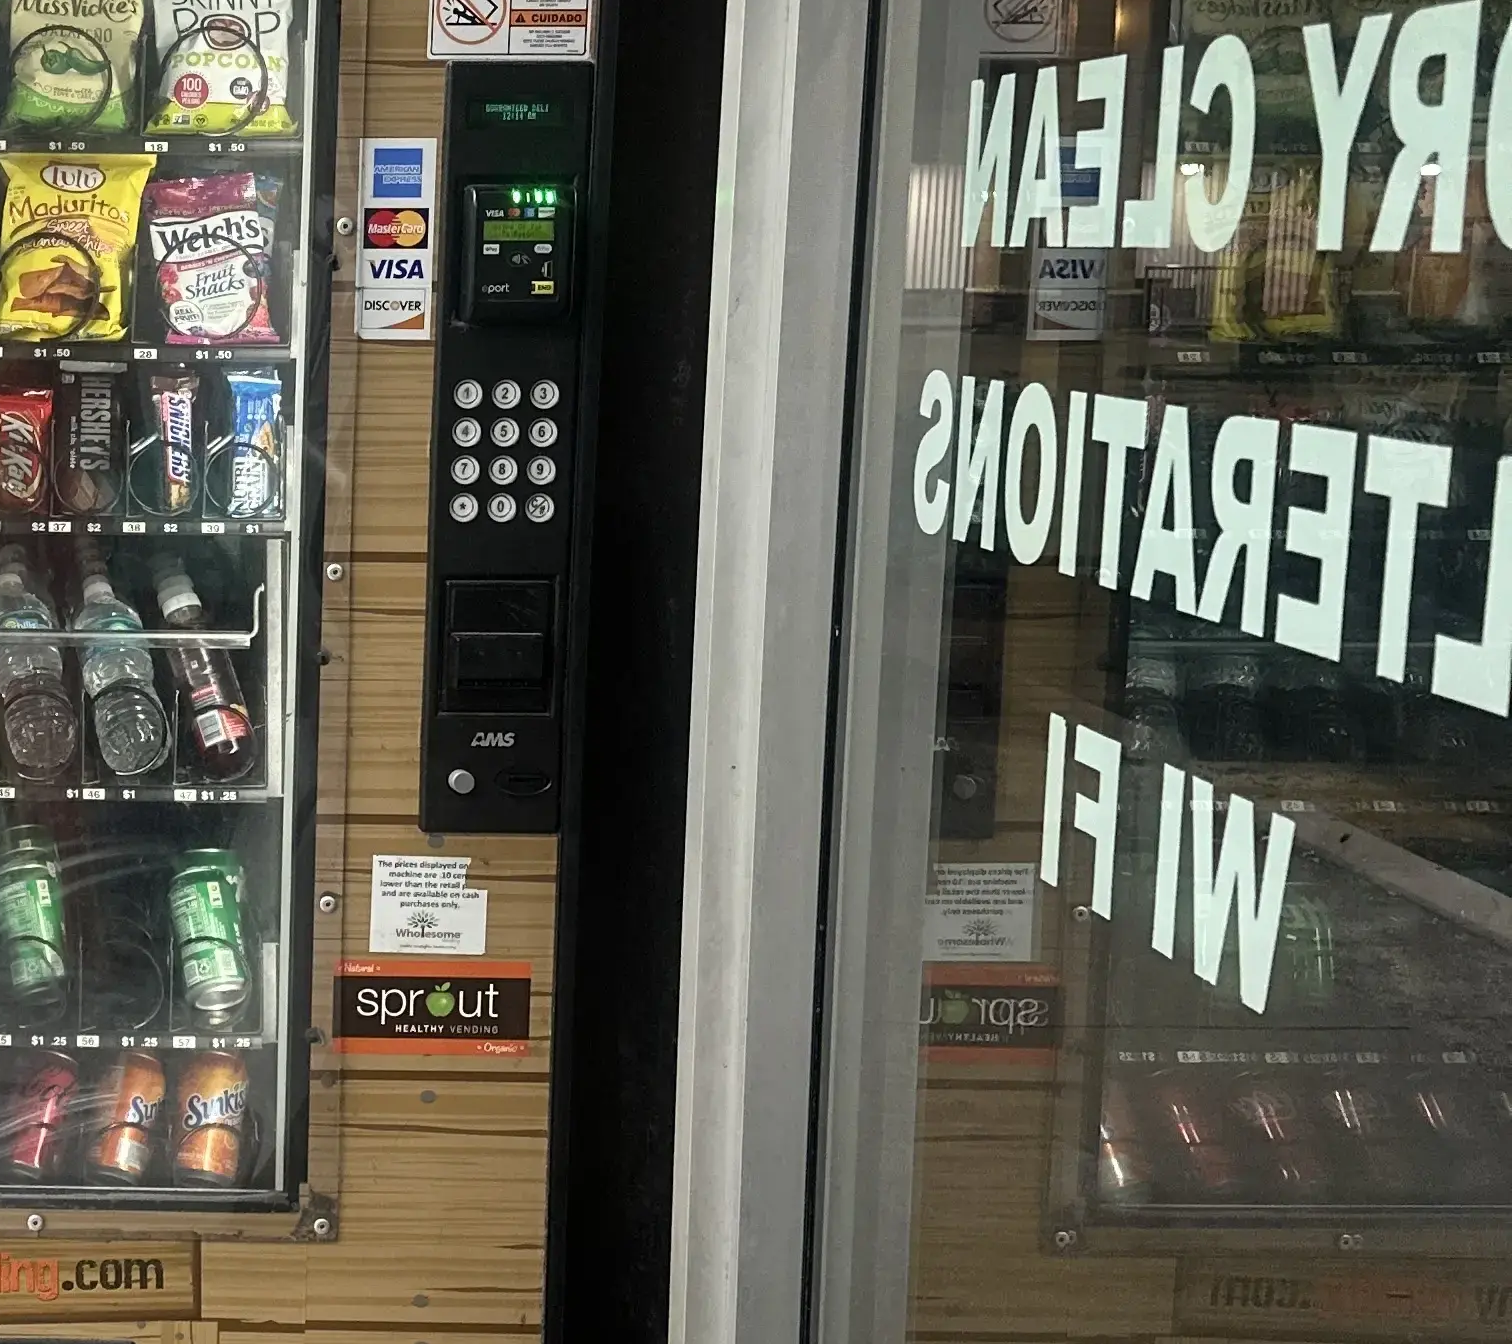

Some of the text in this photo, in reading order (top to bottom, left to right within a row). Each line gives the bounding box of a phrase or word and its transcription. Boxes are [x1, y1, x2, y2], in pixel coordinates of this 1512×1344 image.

[531, 14, 582, 23] CUIDADO
[181, 77, 202, 91] 100
[150, 144, 163, 152] 18
[374, 164, 420, 174] AMERICAN
[383, 175, 422, 184] EXPRESS
[9, 194, 131, 225] Maduritos
[485, 209, 504, 218] VISA
[46, 219, 90, 234] Sweet
[368, 223, 424, 235] MasterCard
[156, 215, 260, 255] Welch's
[195, 263, 236, 287] Fruit
[368, 259, 424, 279] VISA
[185, 277, 245, 300] Snacks
[364, 300, 422, 311] DISCOVER
[139, 350, 152, 358] 28
[463, 387, 470, 399] 1
[501, 387, 509, 400] 2
[540, 387, 547, 400] 3
[79, 375, 112, 471] HERSHEY'S
[462, 425, 469, 438] 4
[500, 425, 508, 437] 5
[538, 425, 546, 438] 6
[461, 462, 468, 475] 7
[498, 463, 506, 475] 8
[536, 463, 544, 475] 9
[497, 500, 504, 512] 0
[53, 523, 66, 531] 37
[471, 732, 515, 747] AMS
[87, 790, 101, 799] 46
[378, 860, 457, 870] The prices displayed
[388, 870, 422, 878] machine
[439, 881, 460, 889] retail
[413, 890, 448, 898] available
[400, 900, 439, 908] purchases
[395, 928, 461, 939] Wholesome
[395, 1024, 499, 1034] HEALTHY VENDING
[483, 1041, 518, 1054] Organic
